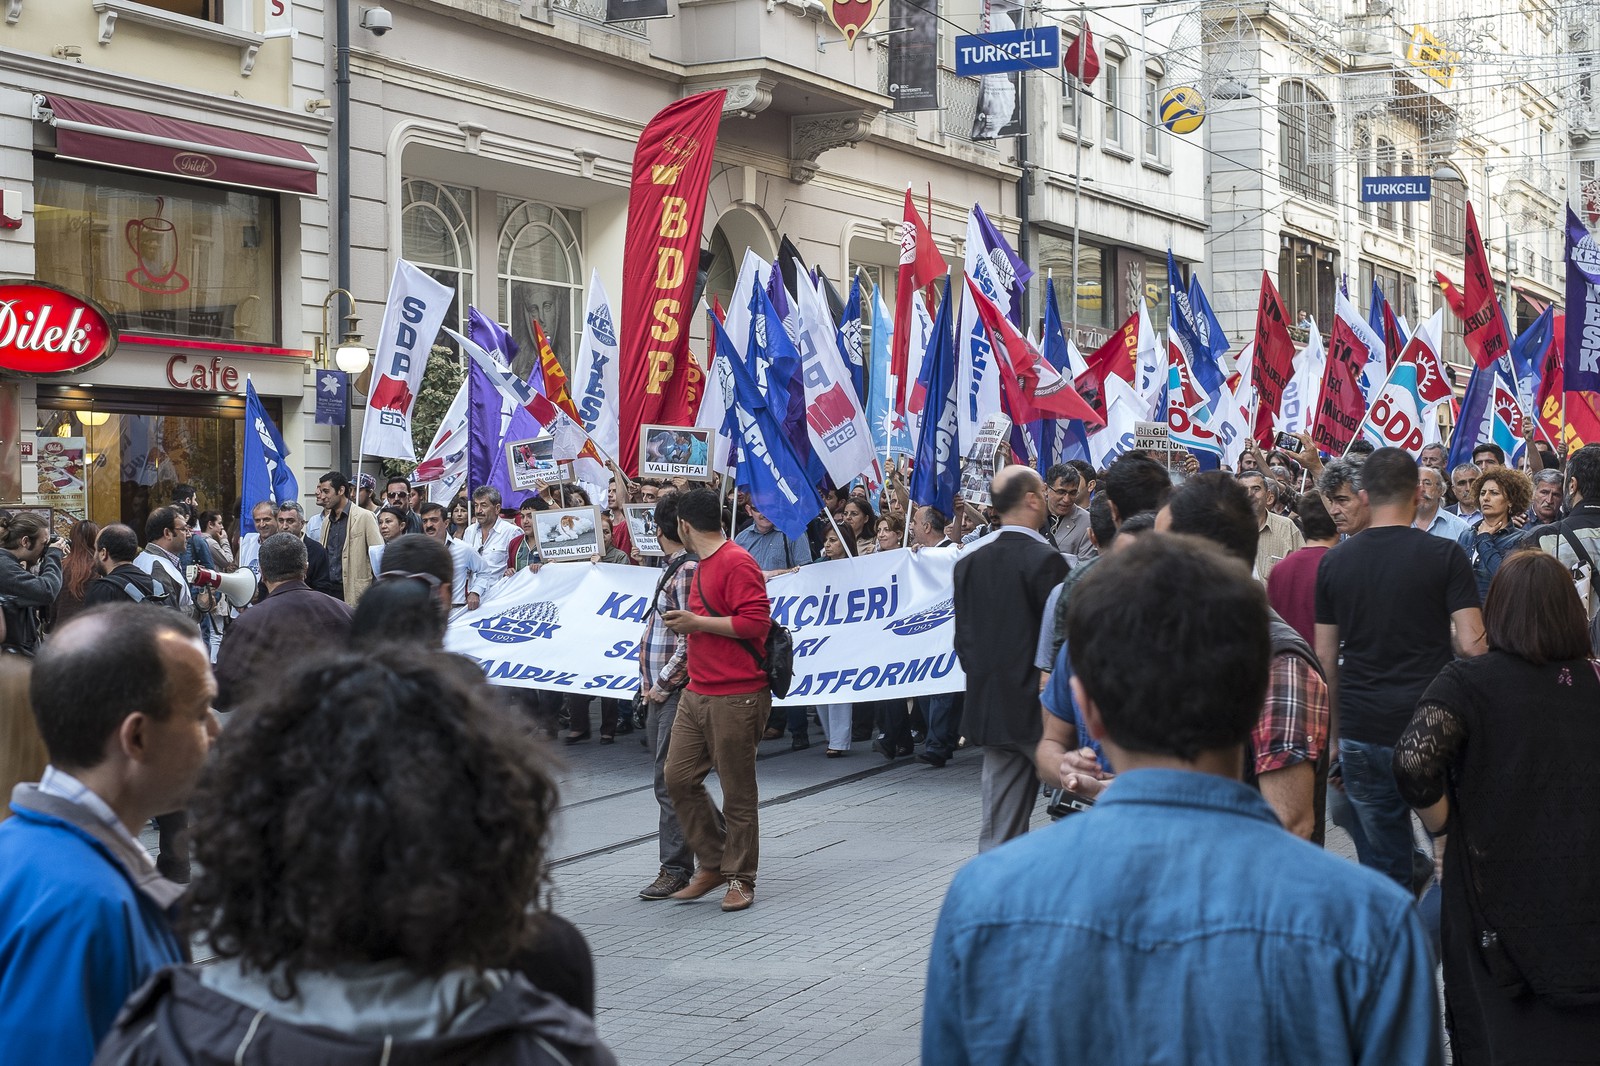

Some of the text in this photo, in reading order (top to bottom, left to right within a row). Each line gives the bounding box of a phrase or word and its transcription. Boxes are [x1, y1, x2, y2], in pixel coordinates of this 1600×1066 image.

[961, 39, 1052, 65] TURKCELL
[181, 156, 206, 173] Dilek
[1365, 183, 1427, 195] TURKCELL
[646, 195, 688, 396] BDSP
[390, 296, 426, 377] SDP
[166, 354, 239, 391] Cafe
[1370, 393, 1424, 452] ÖDP
[1135, 440, 1154, 448] AKP
[648, 463, 705, 475] VALİ İSTİFA!
[543, 546, 575, 556] MARJİNAL
[576, 544, 593, 554] KEDİ
[469, 615, 562, 640] KESK
[491, 633, 517, 643] 1995
